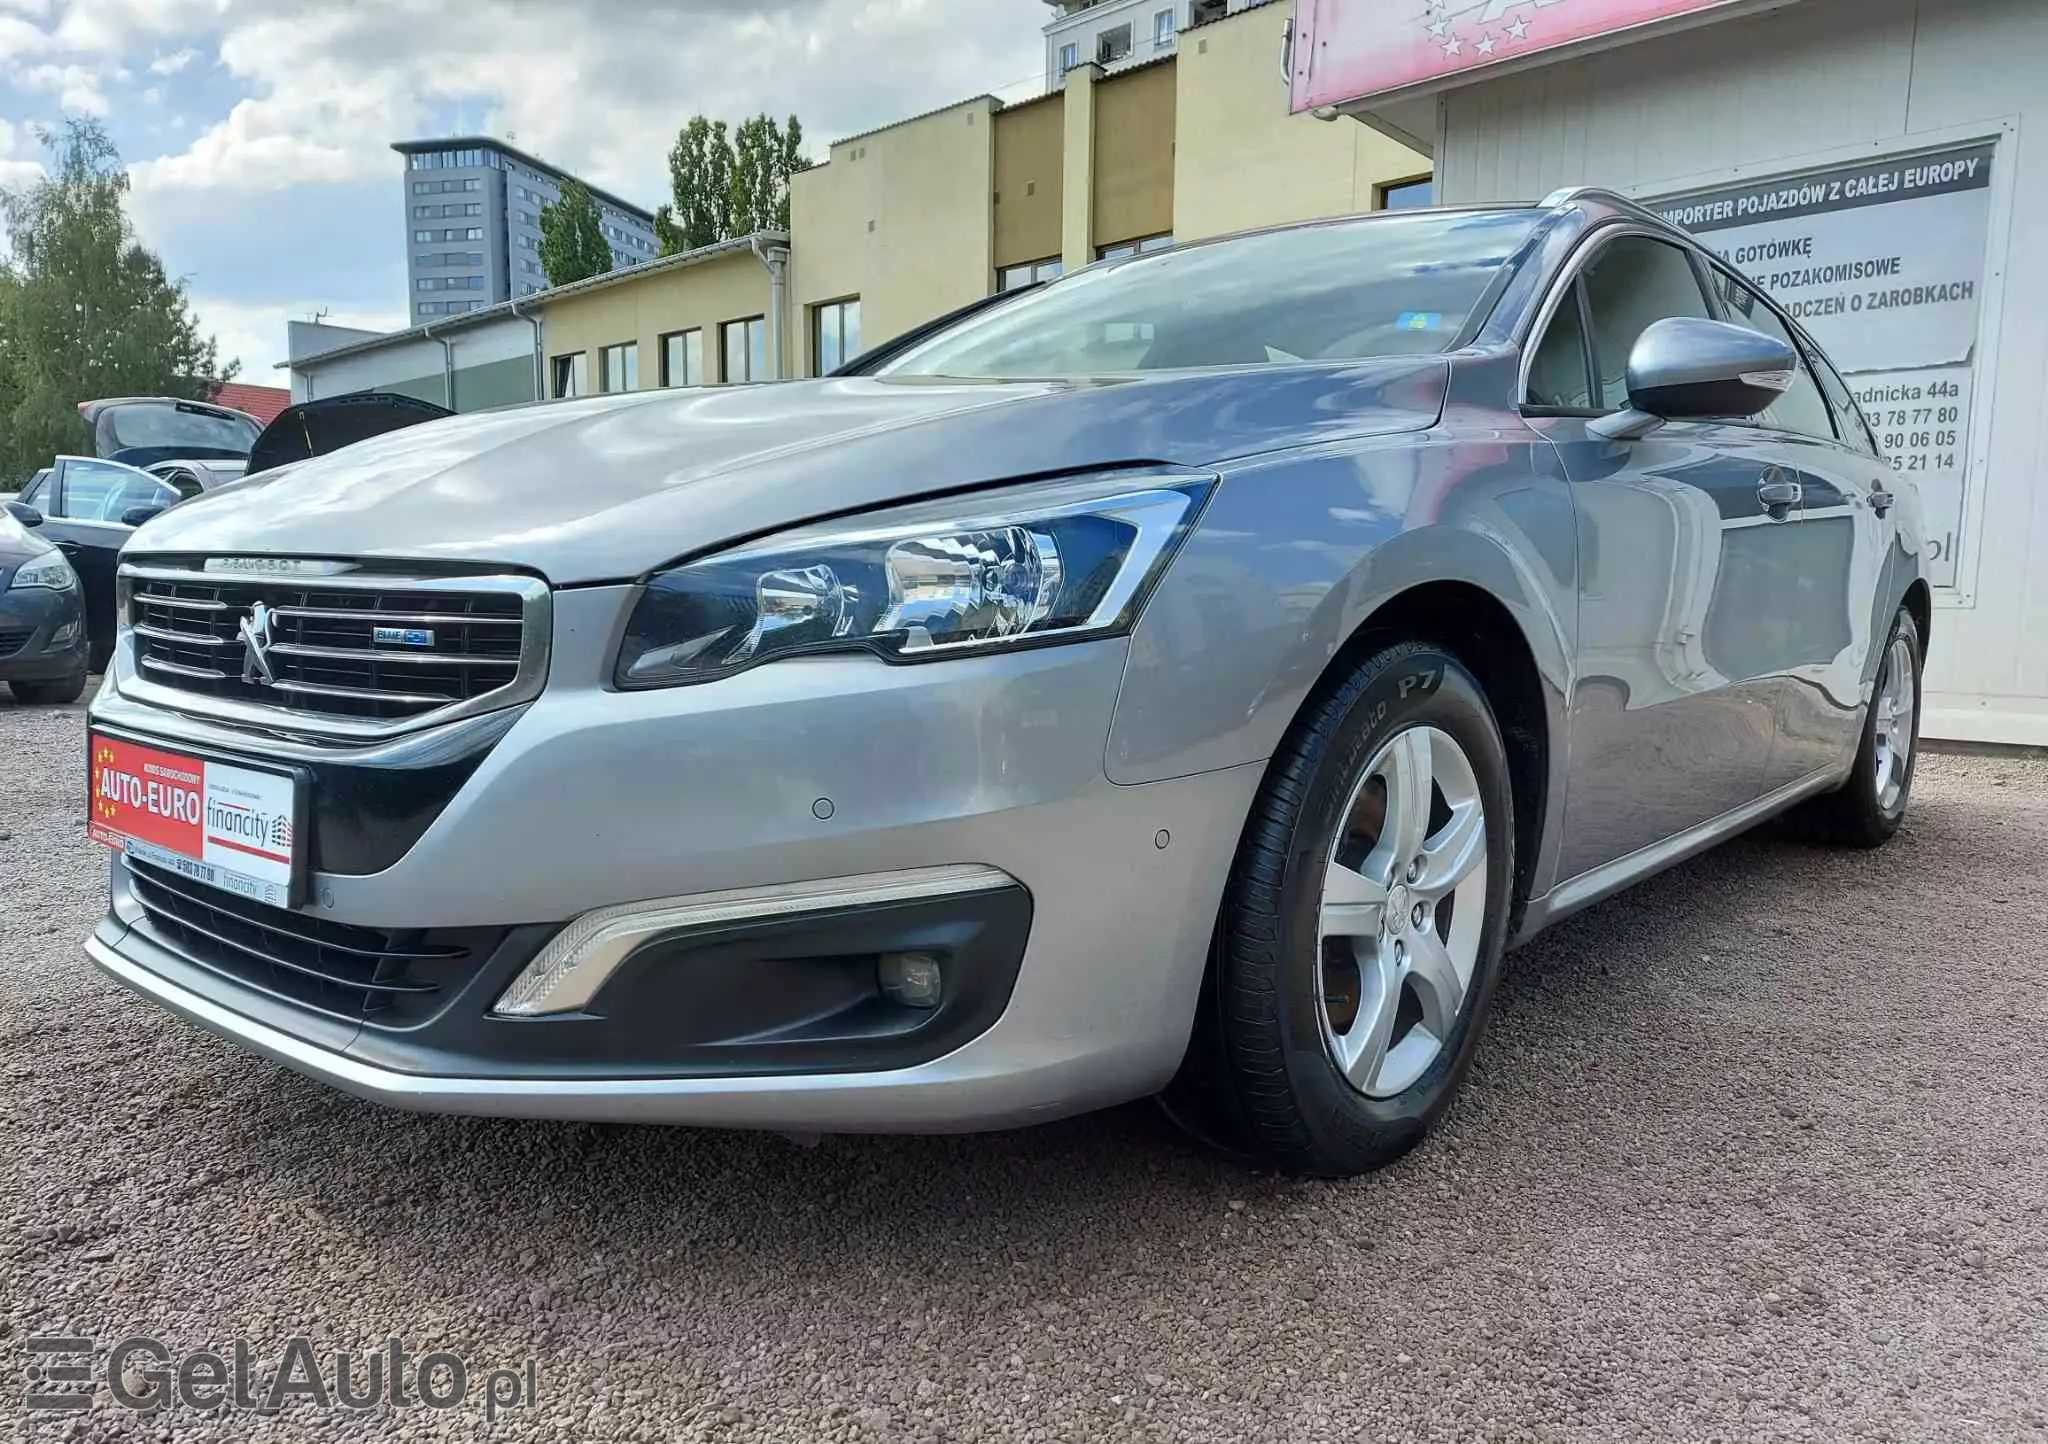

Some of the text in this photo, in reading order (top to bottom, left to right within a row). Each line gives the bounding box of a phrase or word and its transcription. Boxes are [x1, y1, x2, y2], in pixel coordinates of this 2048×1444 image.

[1658, 158, 1979, 225] MPORTER POJAZDÓW Z CAŁEJ EUROPY
[1735, 237, 1812, 264] GOTÓWKĘ
[1770, 257, 1901, 290] POZAKOMISOWE
[1851, 294, 1862, 312] O
[1867, 281, 1974, 310] ZAROBKACH
[1927, 381, 1959, 398] 44a
[1887, 410, 1906, 426] 78
[1913, 408, 1931, 425] 77
[1937, 406, 1958, 423] 80
[1910, 432, 1929, 447] 06
[1935, 430, 1956, 446] 05
[1907, 455, 1926, 470] 21
[1935, 453, 1954, 468] 14
[1398, 670, 1437, 698] P7
[101, 767, 200, 826] AUTO-EURO
[207, 796, 269, 847] financity
